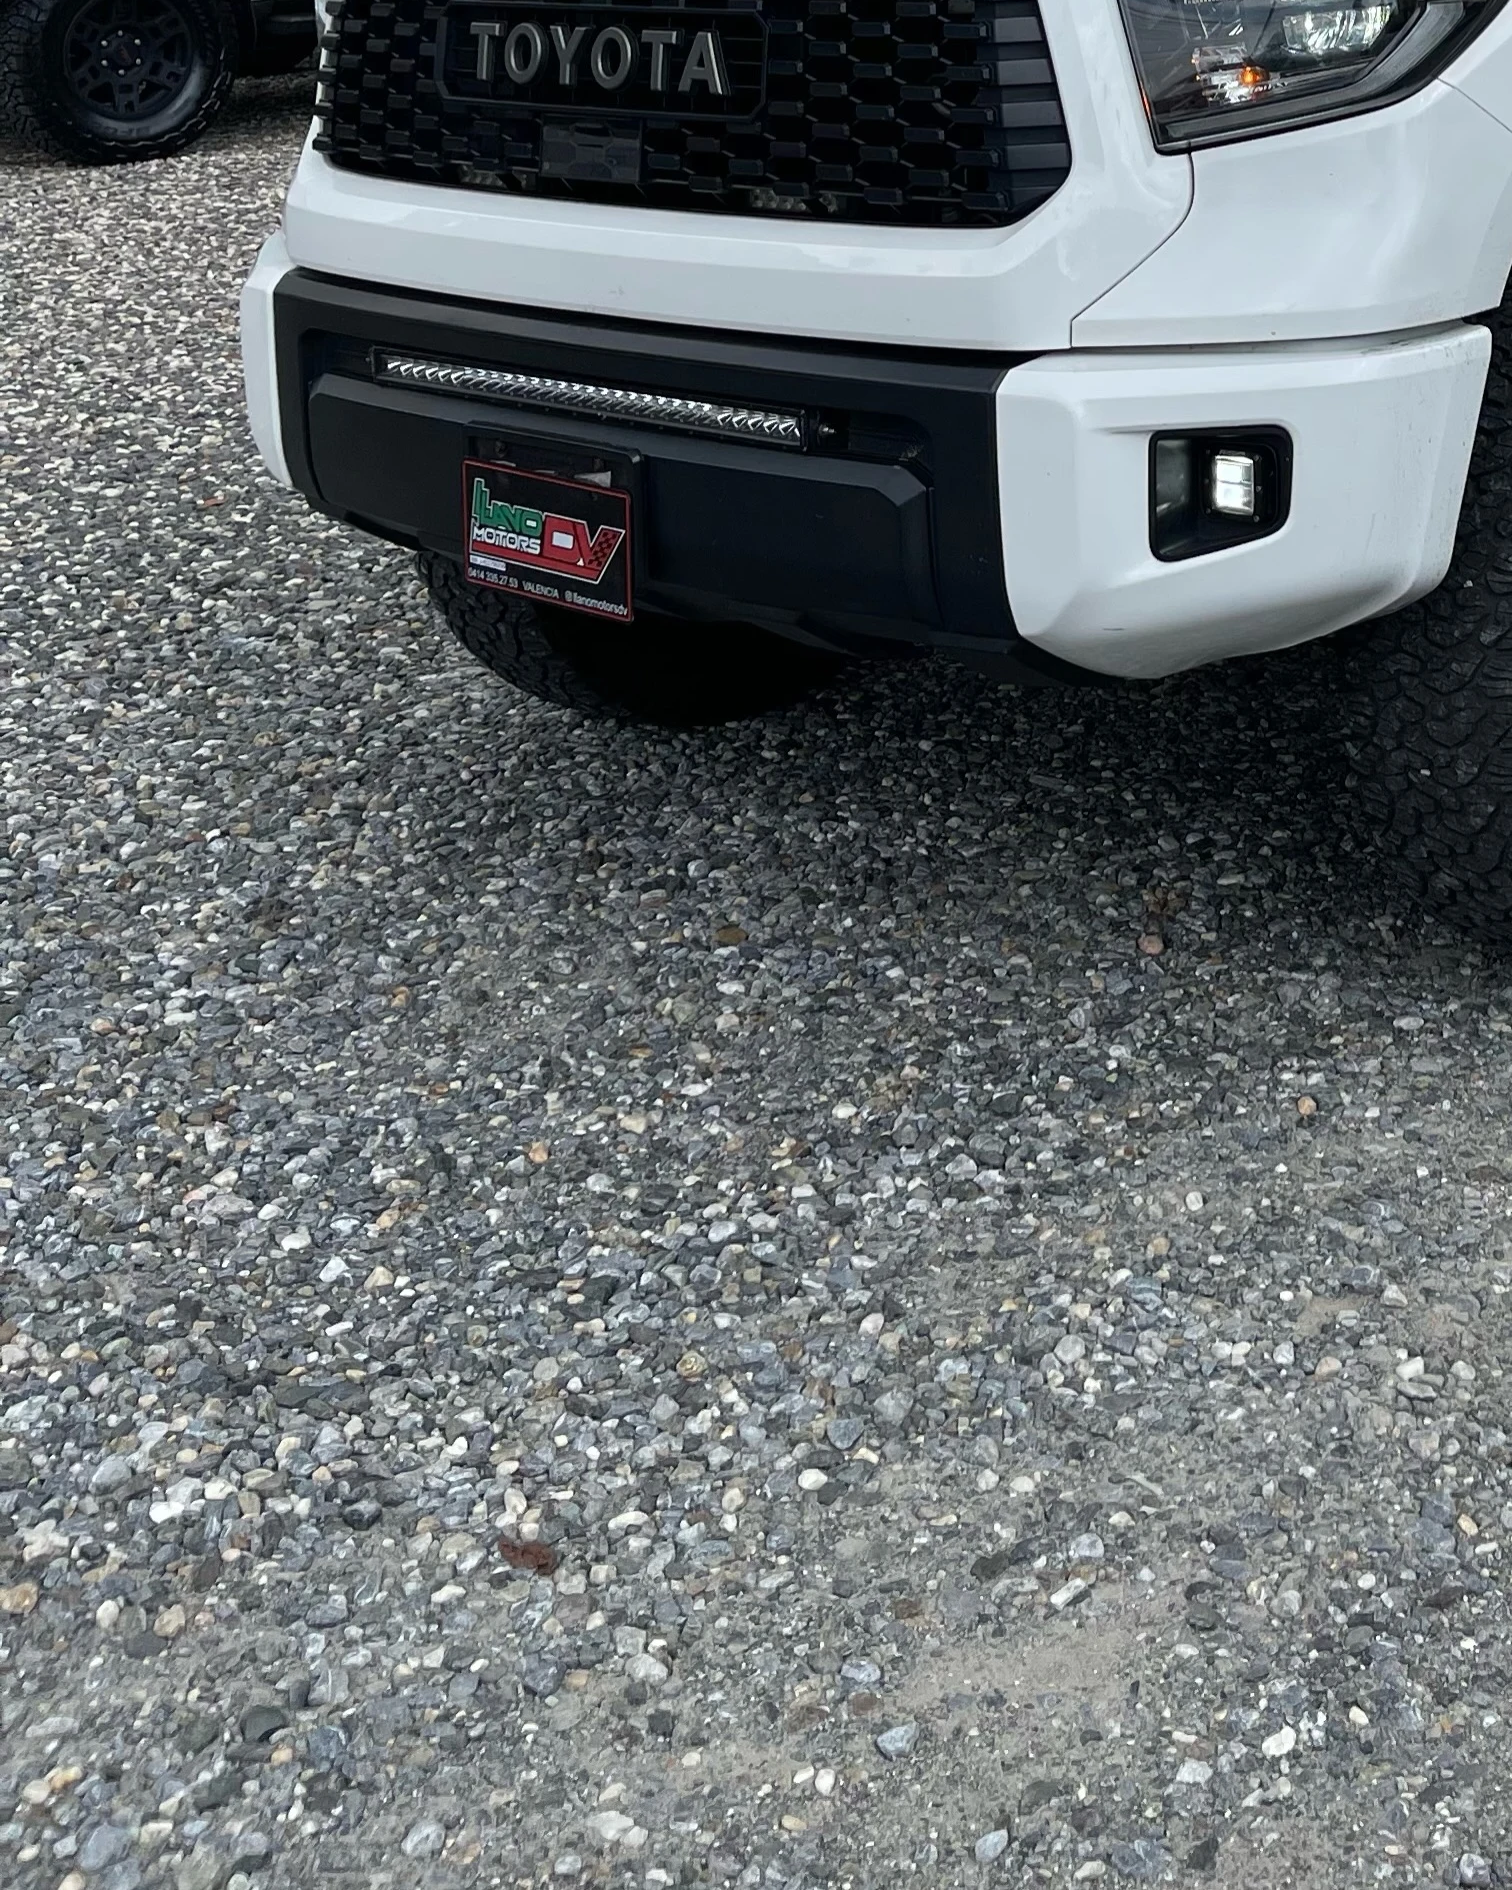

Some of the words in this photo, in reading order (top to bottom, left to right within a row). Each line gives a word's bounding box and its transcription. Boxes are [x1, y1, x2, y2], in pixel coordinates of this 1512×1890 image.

[469, 21, 729, 95] TOYOTA
[472, 527, 542, 555] MOTORS
[522, 580, 560, 599] VALENCIA
